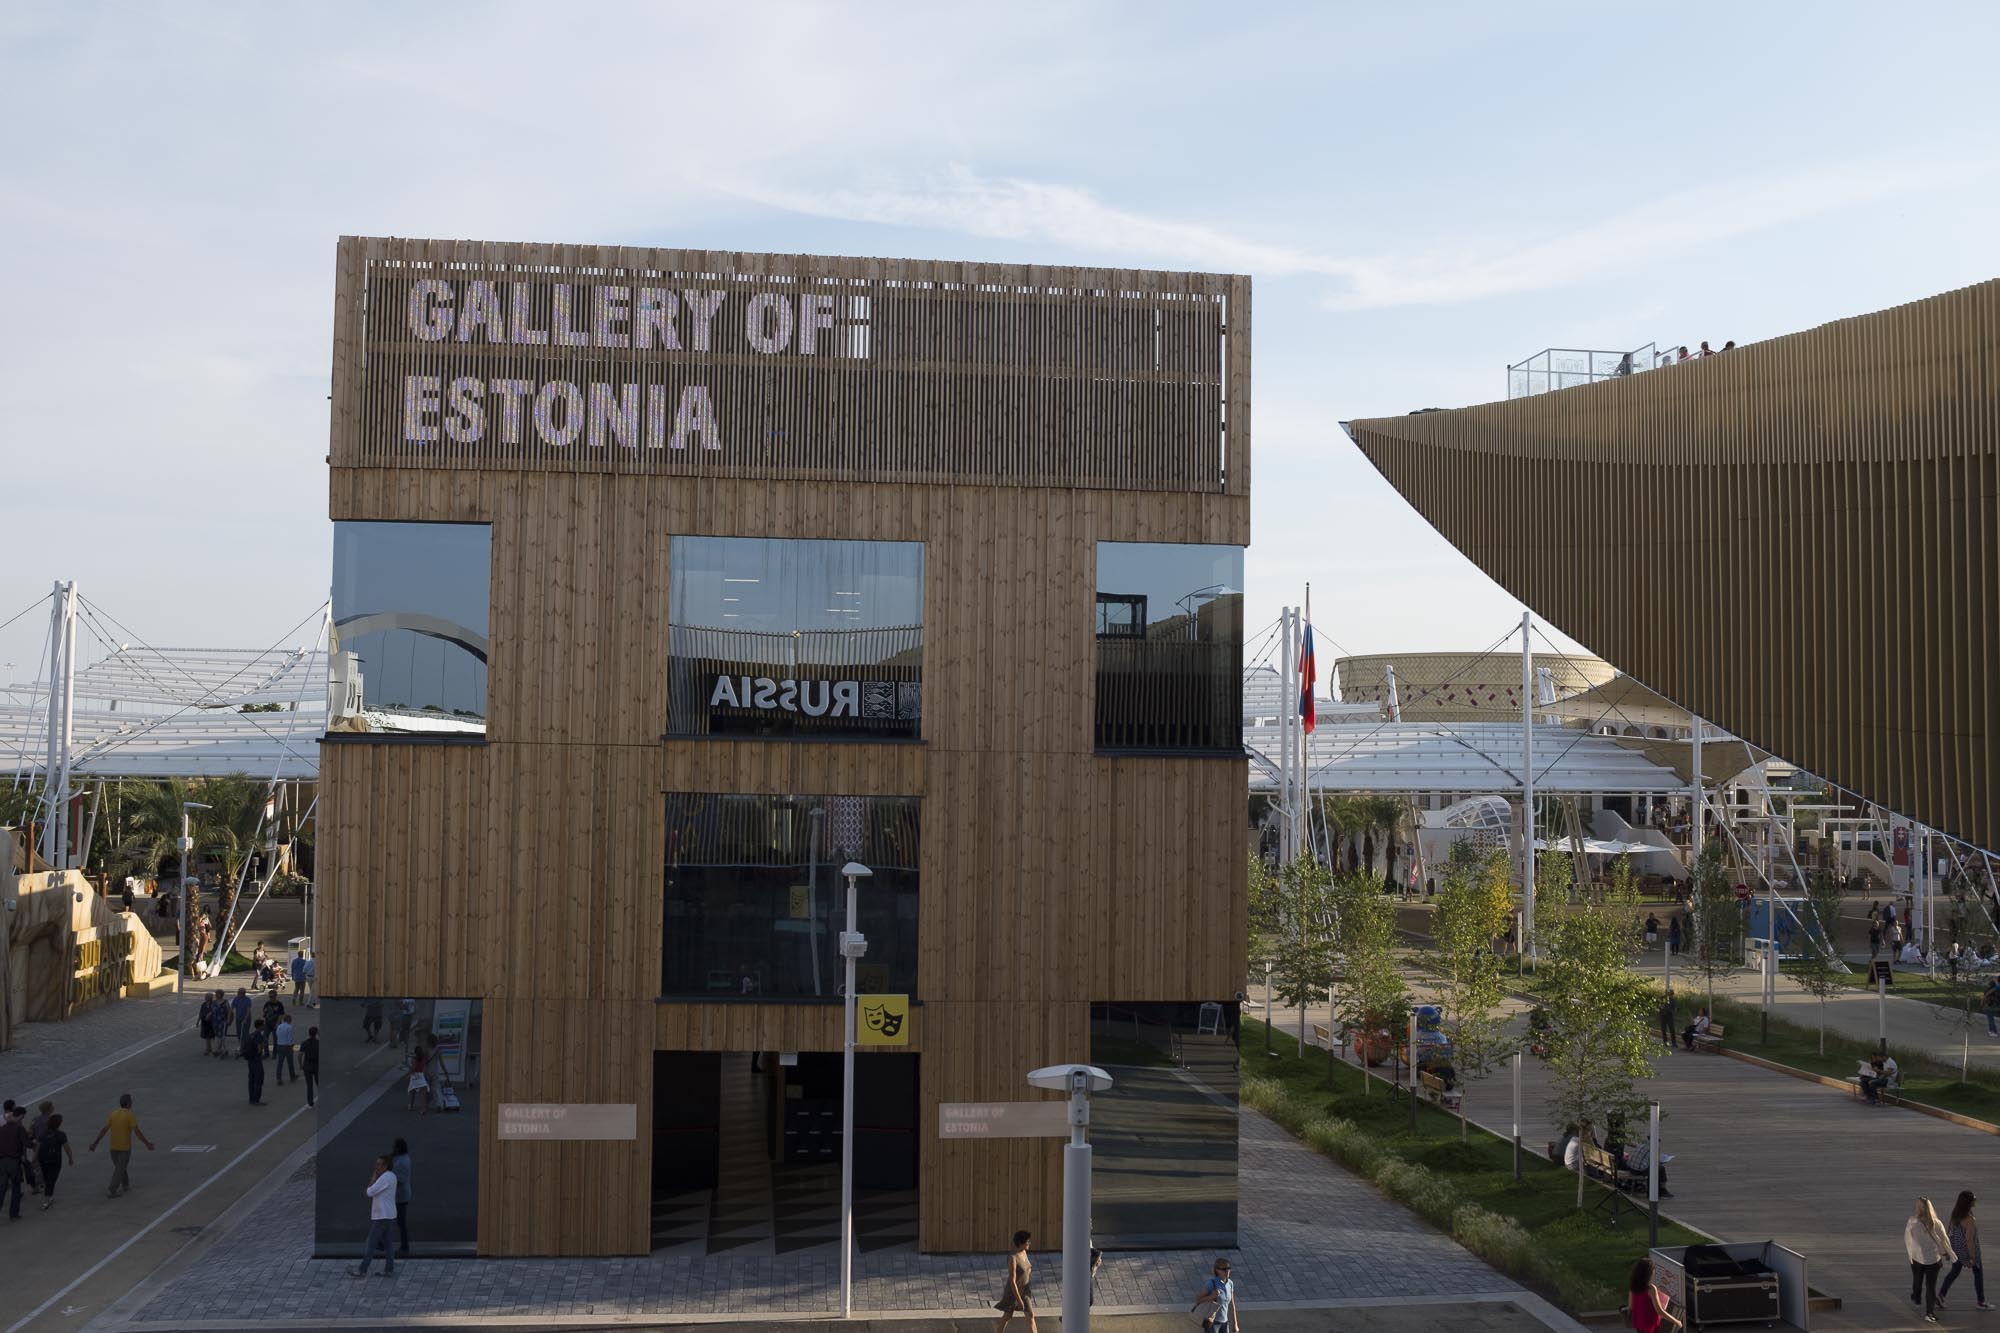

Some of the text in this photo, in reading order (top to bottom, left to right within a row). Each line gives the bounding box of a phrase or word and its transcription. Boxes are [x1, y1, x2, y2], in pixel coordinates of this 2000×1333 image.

[408, 279, 834, 355] GALLERY OF
[404, 375, 721, 450] ESTONIA
[504, 1107, 567, 1120] GALLERY OF
[945, 1107, 1005, 1119] GALLERY OF
[504, 1123, 550, 1134] ESTONIA
[944, 1122, 989, 1133] ESTONIA
